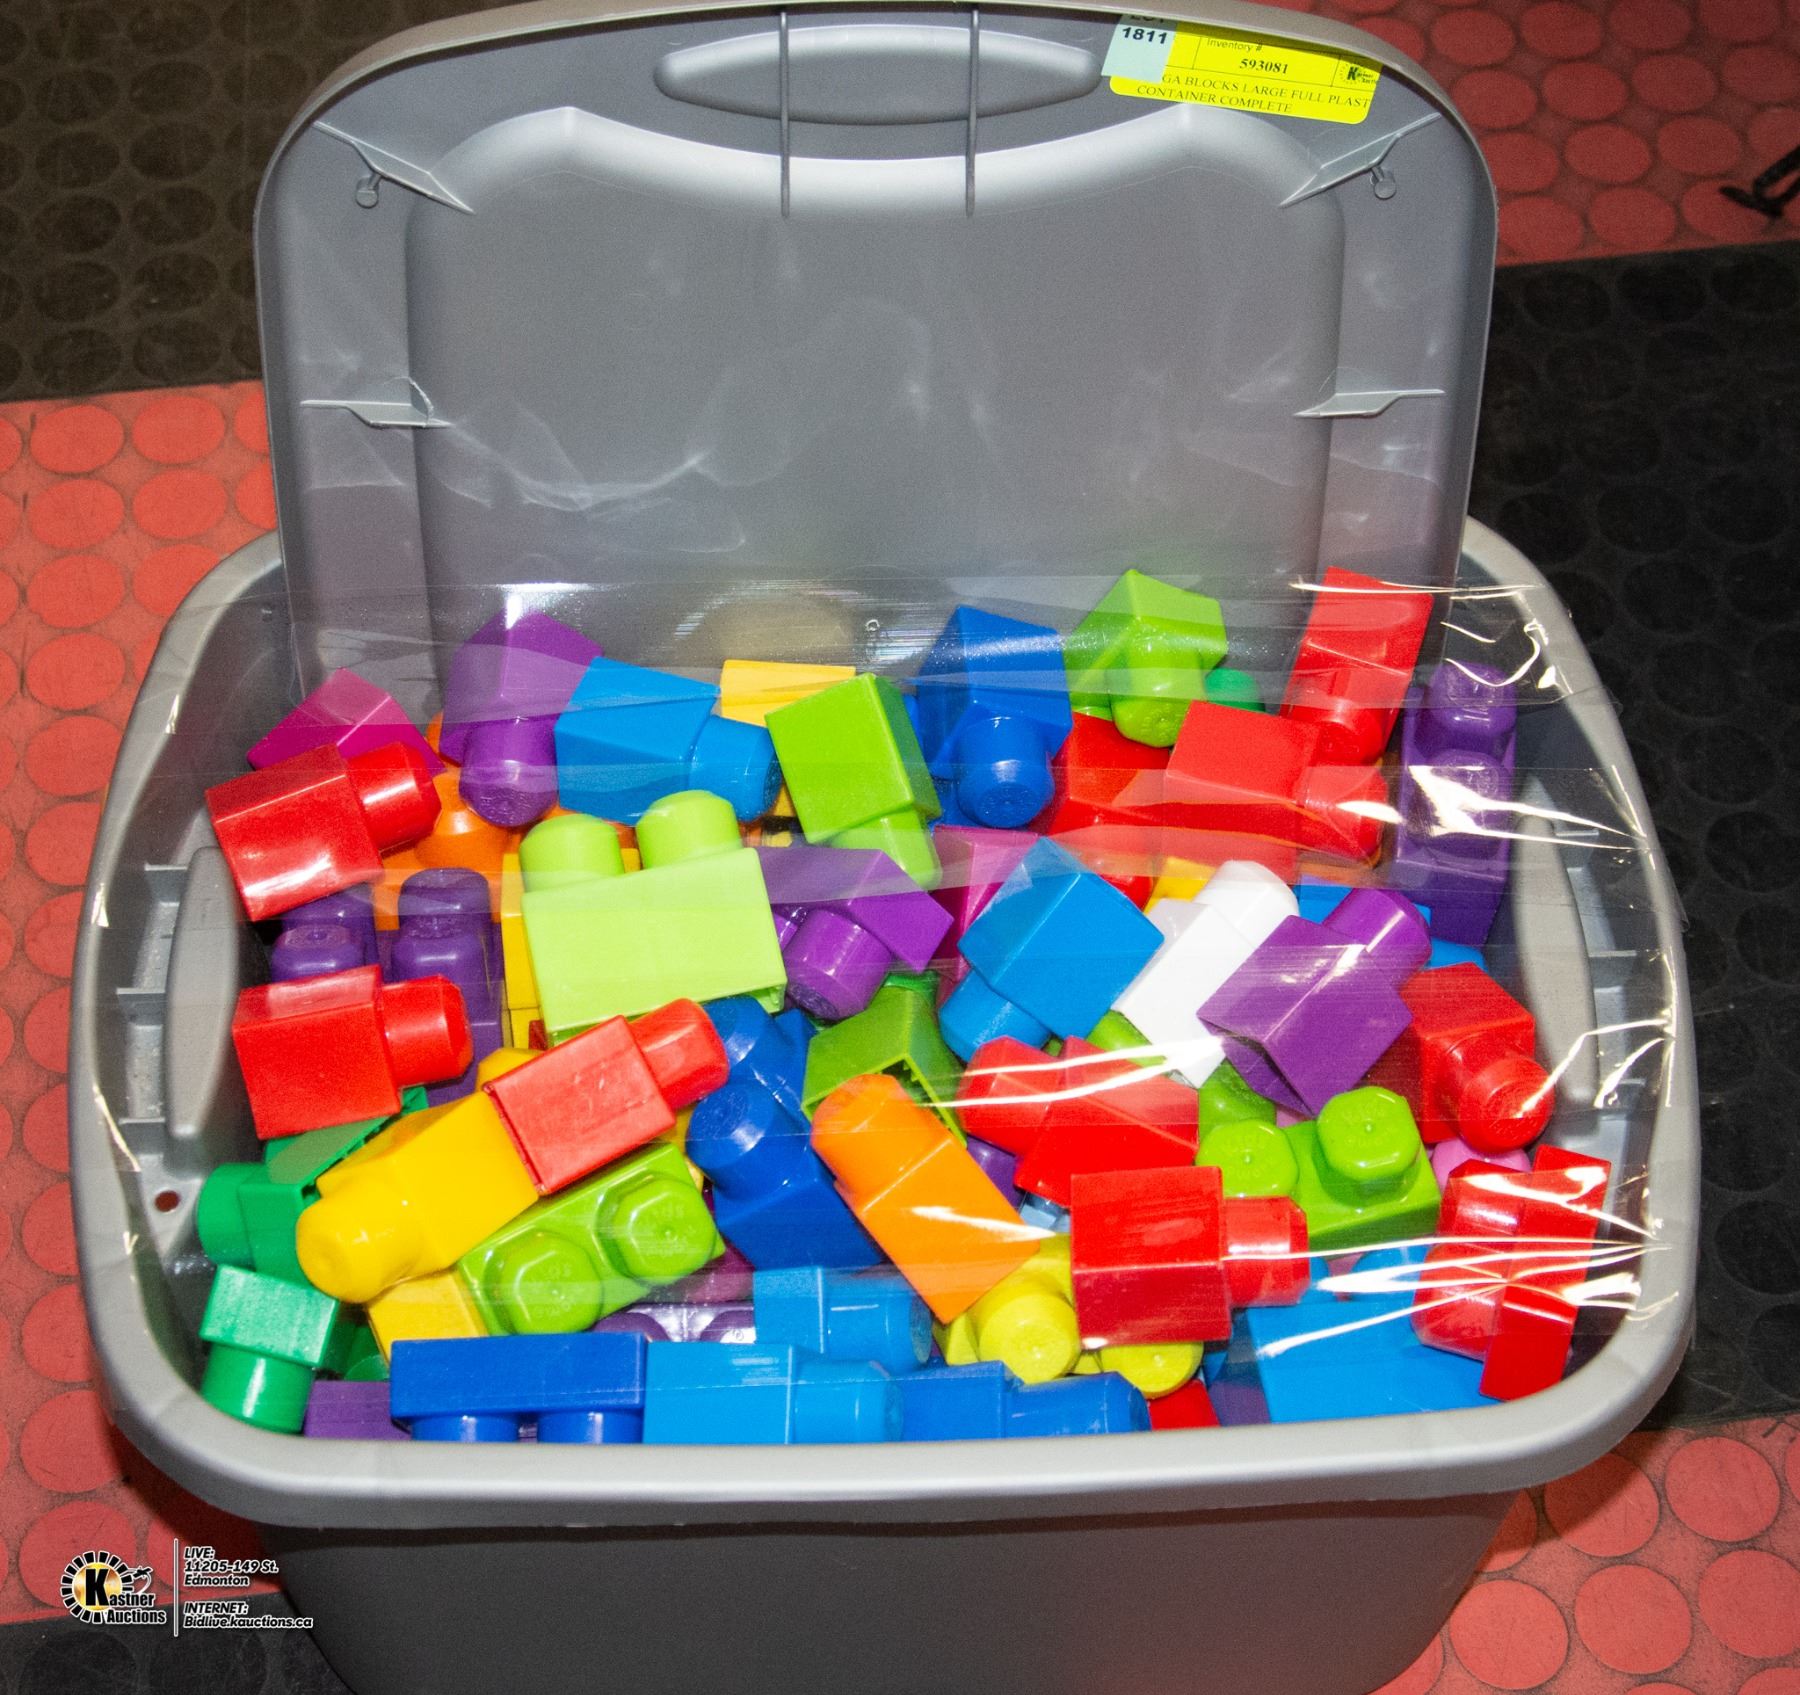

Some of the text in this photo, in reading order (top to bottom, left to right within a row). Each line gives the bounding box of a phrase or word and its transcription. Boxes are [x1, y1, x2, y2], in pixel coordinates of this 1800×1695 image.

[1122, 26, 1167, 44] 1811
[1206, 38, 1263, 51] Inventory #
[1239, 58, 1289, 74] 593081
[1162, 74, 1180, 84] GA
[1185, 77, 1239, 91] BLOCKS
[1243, 83, 1290, 97] LARGE
[1291, 90, 1323, 103] FULL
[1137, 85, 1293, 112] CONTAINER COMPLETE
